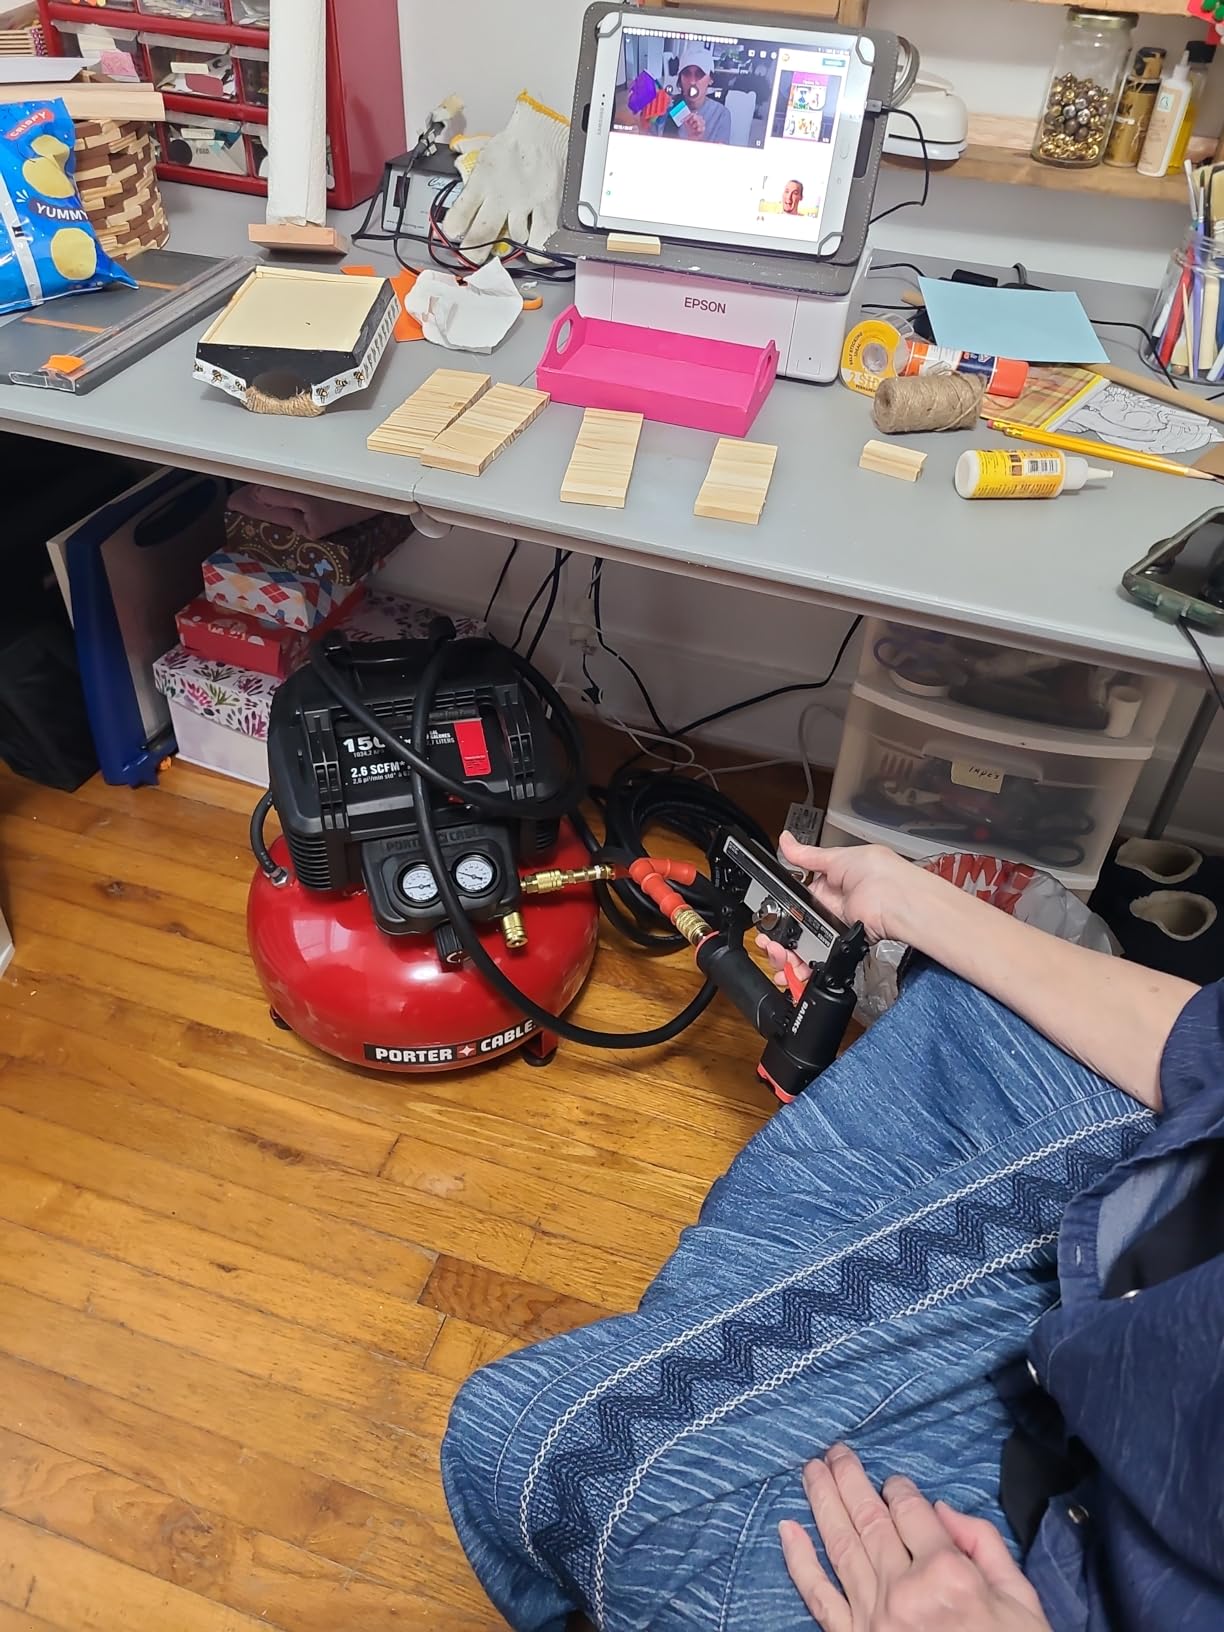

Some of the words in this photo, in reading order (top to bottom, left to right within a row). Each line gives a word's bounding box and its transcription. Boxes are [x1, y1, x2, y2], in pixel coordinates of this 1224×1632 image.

[10, 111, 46, 138] CRISPY
[684, 296, 726, 314] EPSON
[375, 1047, 453, 1063] PORTER
[480, 1019, 534, 1052] CABLE
